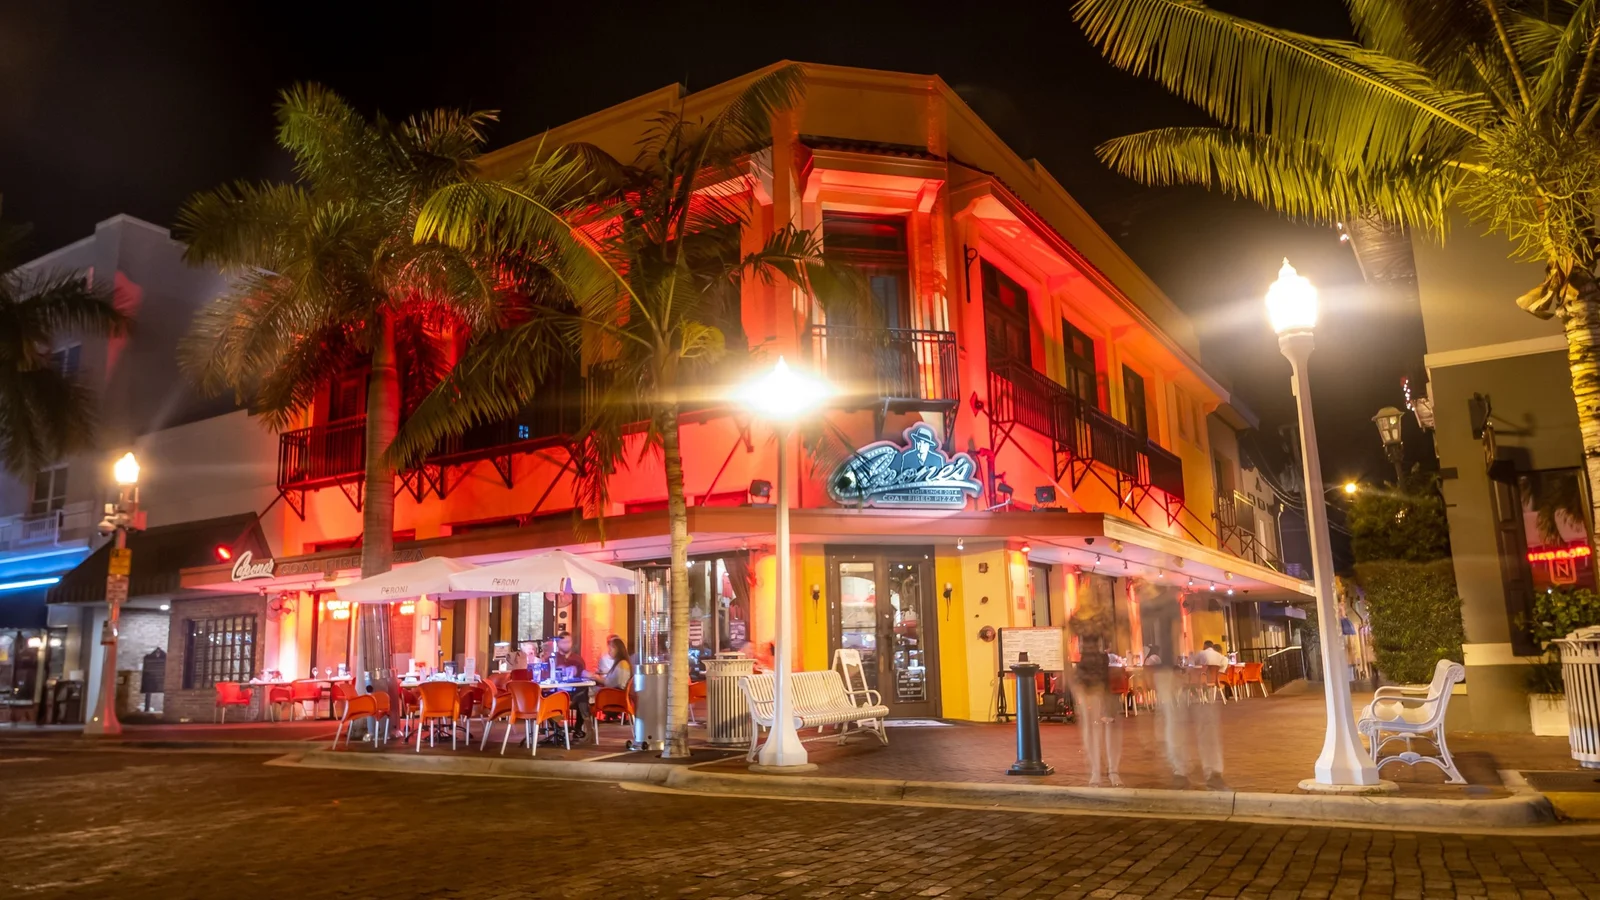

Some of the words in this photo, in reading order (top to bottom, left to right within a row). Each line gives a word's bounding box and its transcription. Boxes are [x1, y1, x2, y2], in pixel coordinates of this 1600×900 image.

[281, 561, 320, 575] COAL
[326, 554, 362, 571] FIRE
[491, 577, 520, 586] PERONI
[380, 585, 409, 595] PERONI
